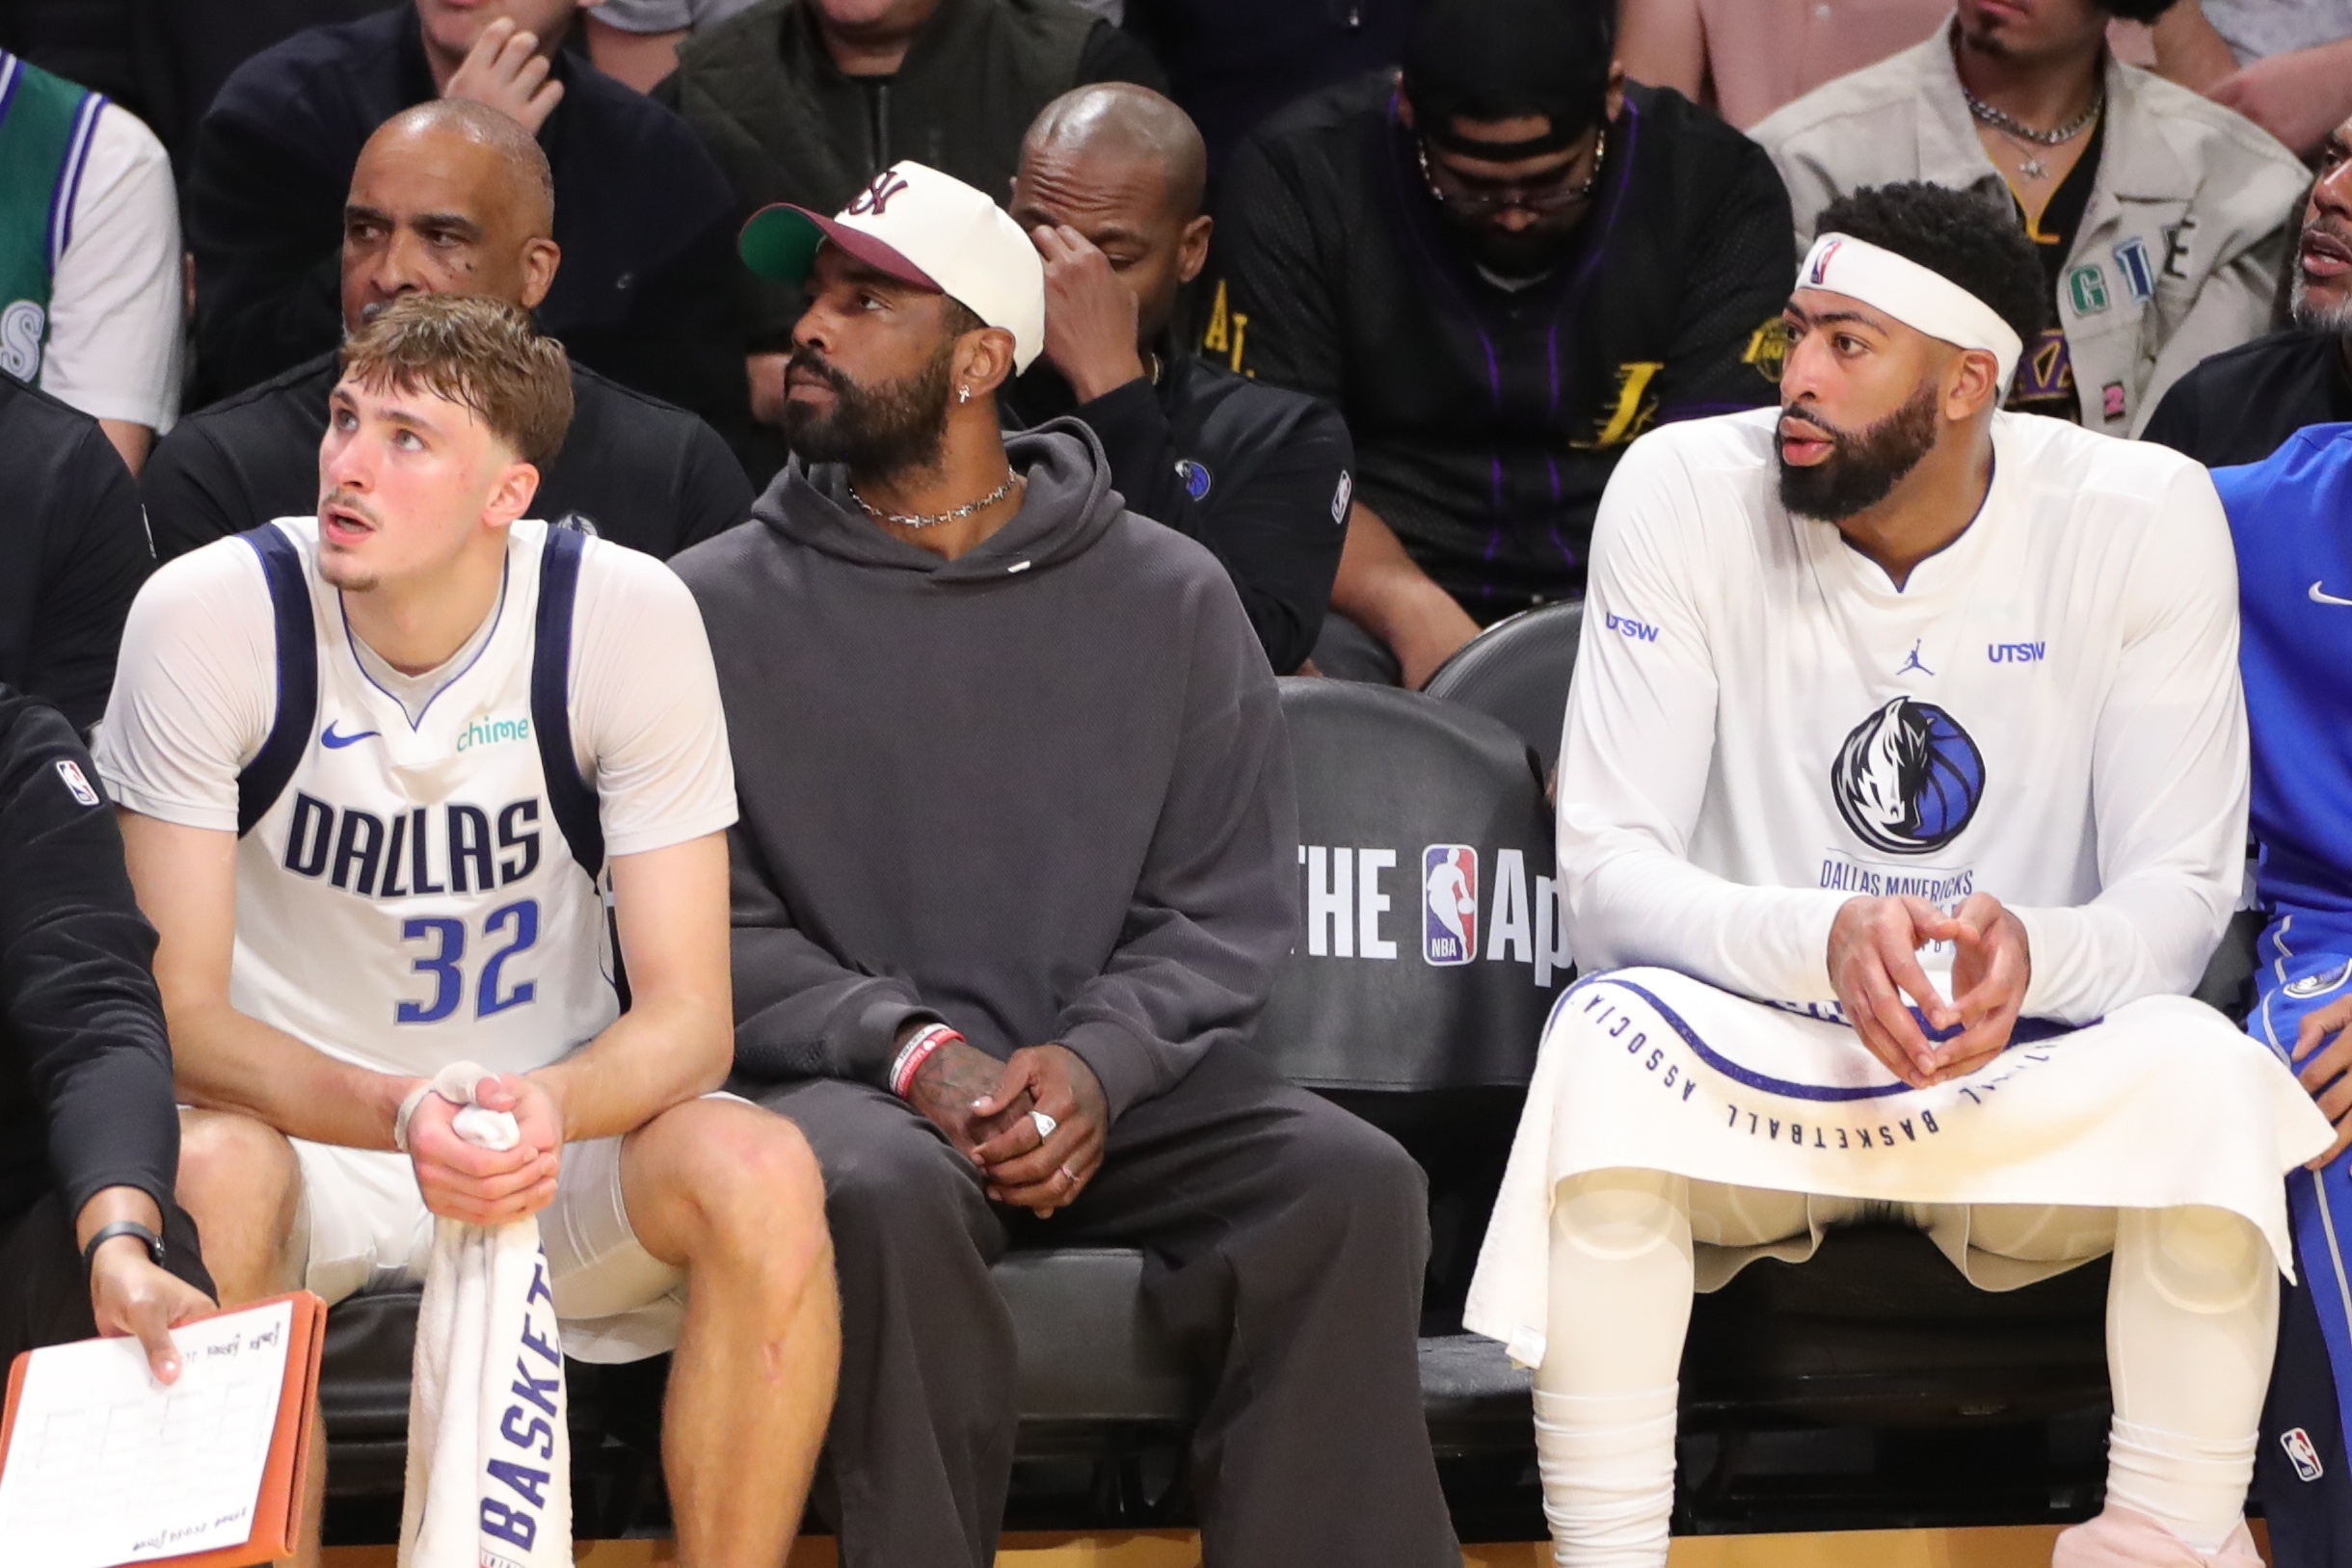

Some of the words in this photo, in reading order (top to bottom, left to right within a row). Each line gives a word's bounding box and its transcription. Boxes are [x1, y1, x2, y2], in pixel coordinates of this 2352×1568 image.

[1988, 640, 2045, 663] UTSW
[456, 717, 529, 753] chime
[282, 787, 543, 901] DALLAS
[1820, 859, 1880, 897] DALLAS
[1884, 868, 1974, 903] MAVERICKS
[392, 895, 543, 1026] 32
[1430, 938, 1457, 958] NBA
[1583, 993, 1697, 1103] ASSOCIA
[1726, 1103, 1941, 1150] BASKETBALL
[479, 1239, 562, 1555] BASKET
